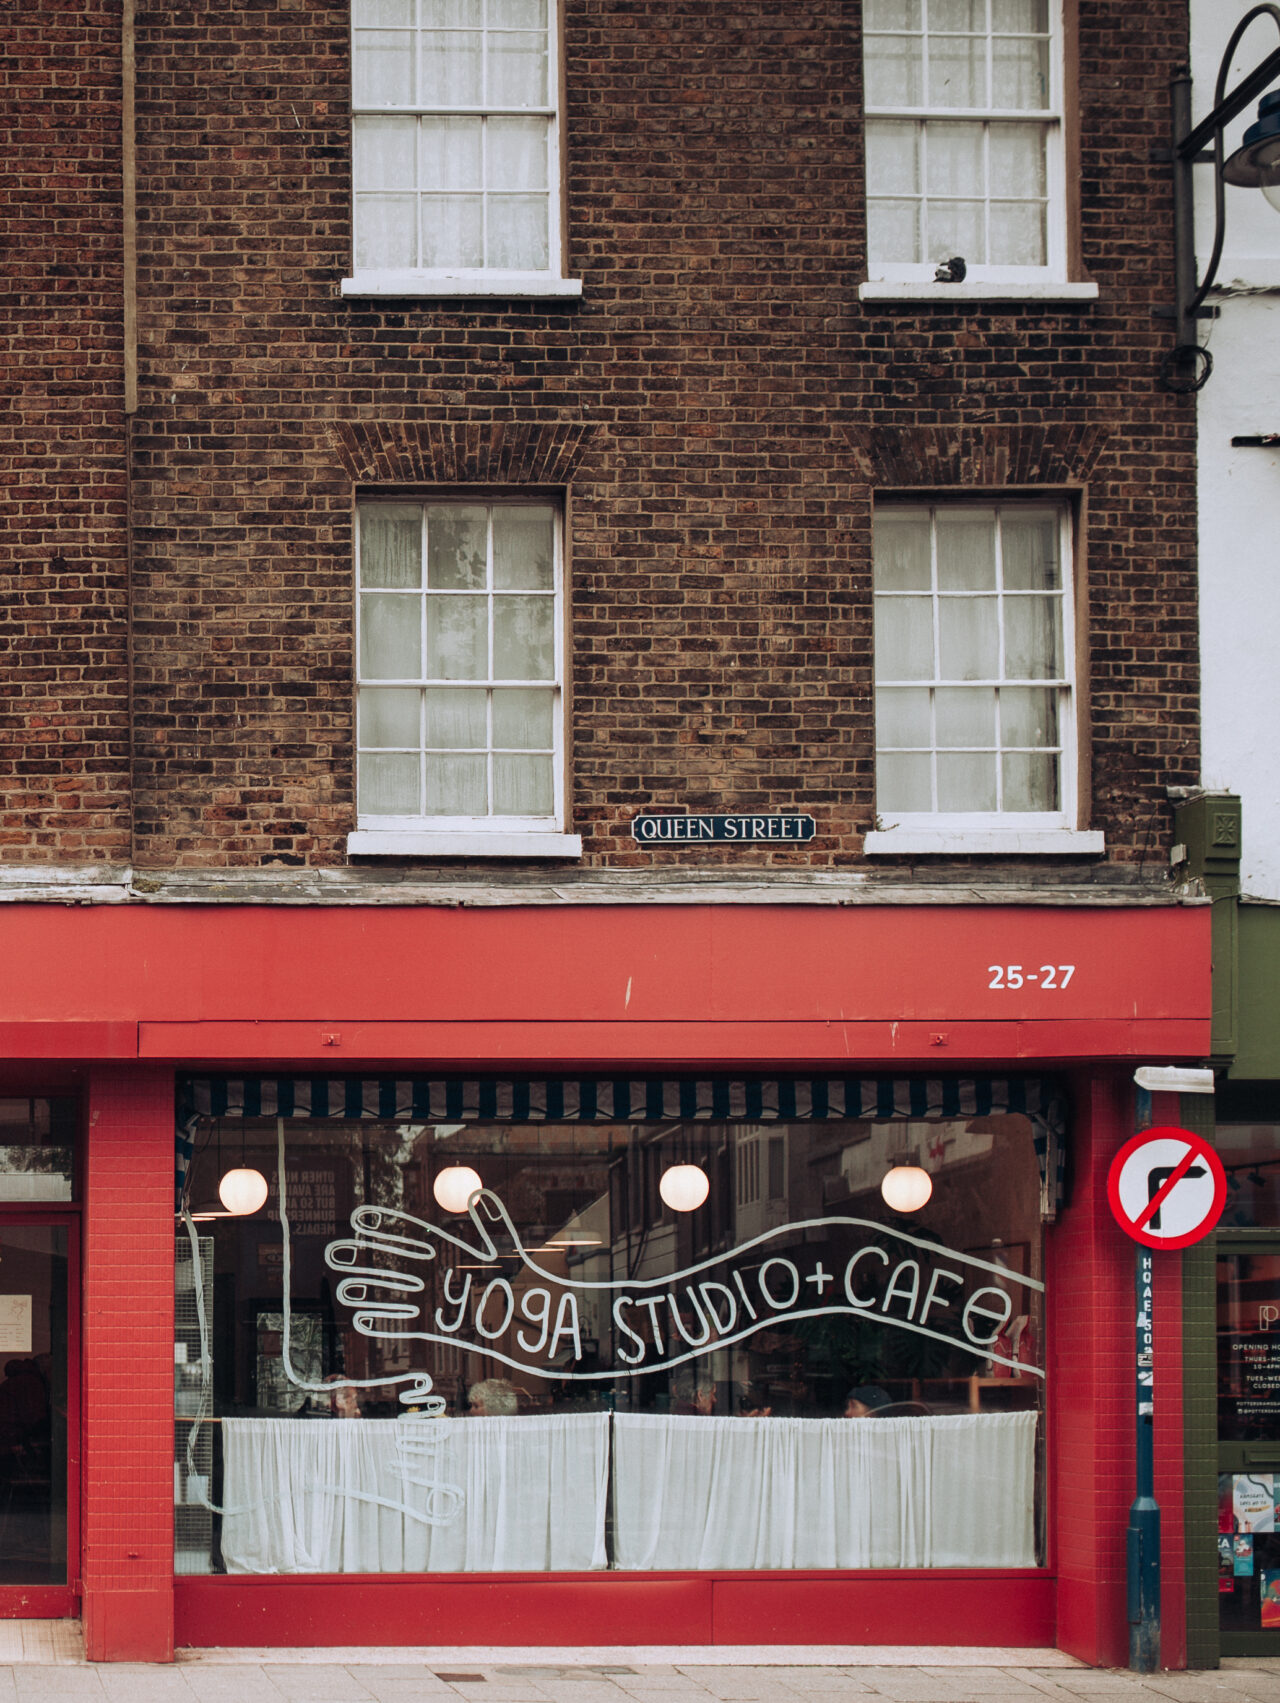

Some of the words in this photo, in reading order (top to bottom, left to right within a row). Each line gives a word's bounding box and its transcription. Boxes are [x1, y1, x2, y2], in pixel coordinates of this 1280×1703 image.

[641, 818, 714, 839] QUEEN
[724, 817, 807, 838] STREET
[987, 965, 1076, 989] 25-27
